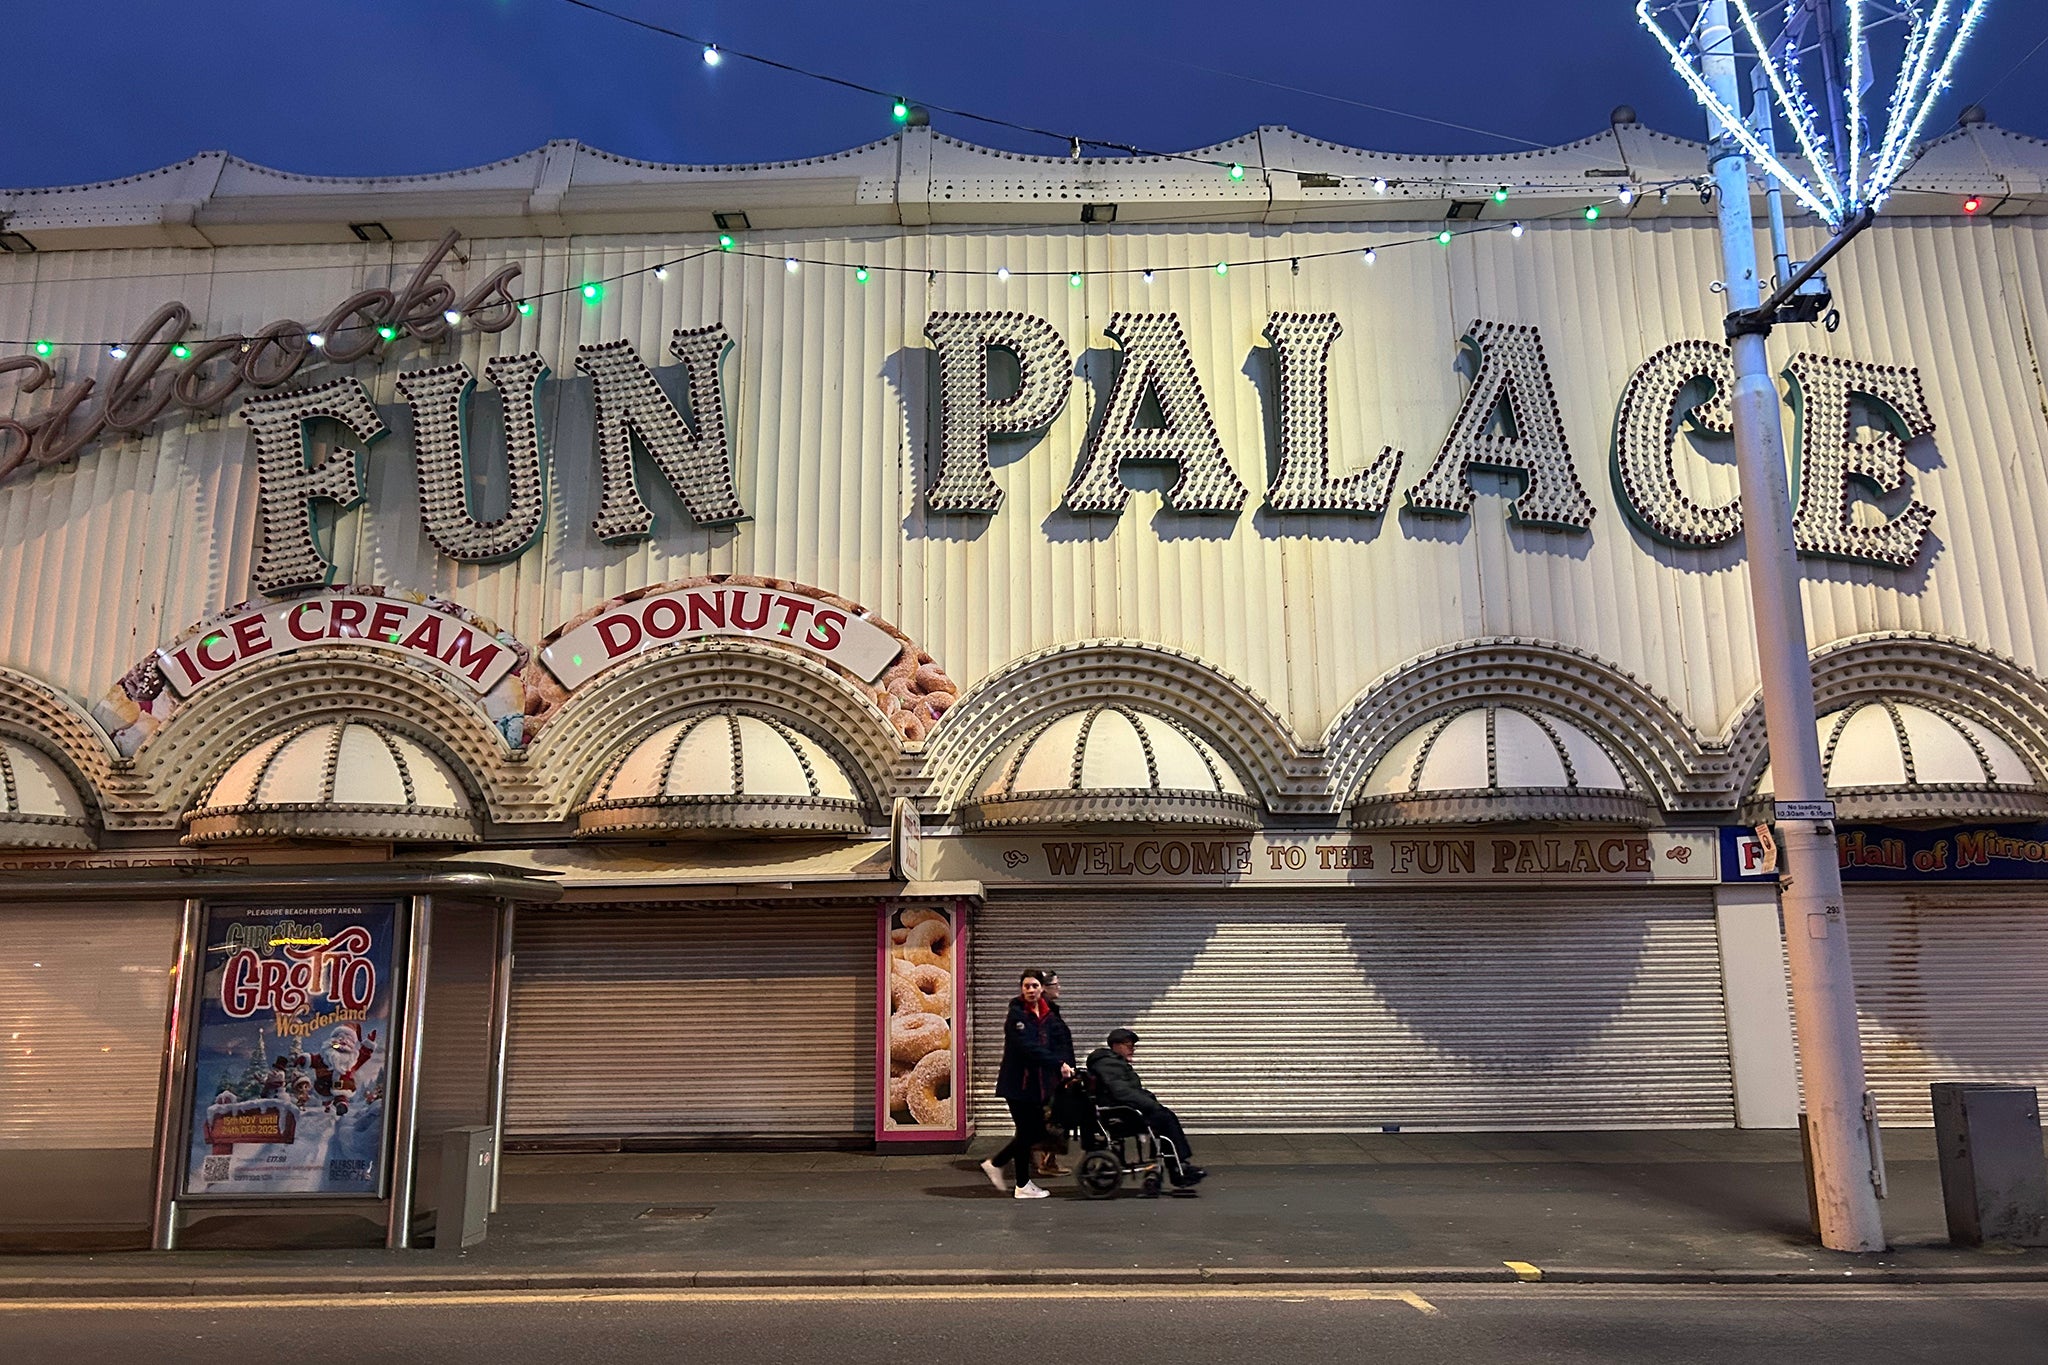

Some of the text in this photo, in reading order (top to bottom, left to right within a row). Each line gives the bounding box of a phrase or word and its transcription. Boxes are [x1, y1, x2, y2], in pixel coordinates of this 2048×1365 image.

[240, 311, 1936, 596] FUN PALACE
[172, 600, 503, 687] ICE CREAM
[593, 589, 848, 659] DONUTS
[1041, 839, 1652, 876] WELCOME TO THE FUN PALACE
[1837, 830, 1907, 870] Hall
[1913, 840, 1949, 872] of
[246, 908, 283, 916] PLEASURE
[309, 907, 337, 915] RESORT
[221, 926, 376, 1018] GROTTO
[275, 1003, 367, 1037] Wonderland
[240, 1116, 256, 1125] NOV
[259, 1115, 278, 1124] until
[240, 1125, 257, 1134] DEC
[257, 1125, 279, 1134] 2025
